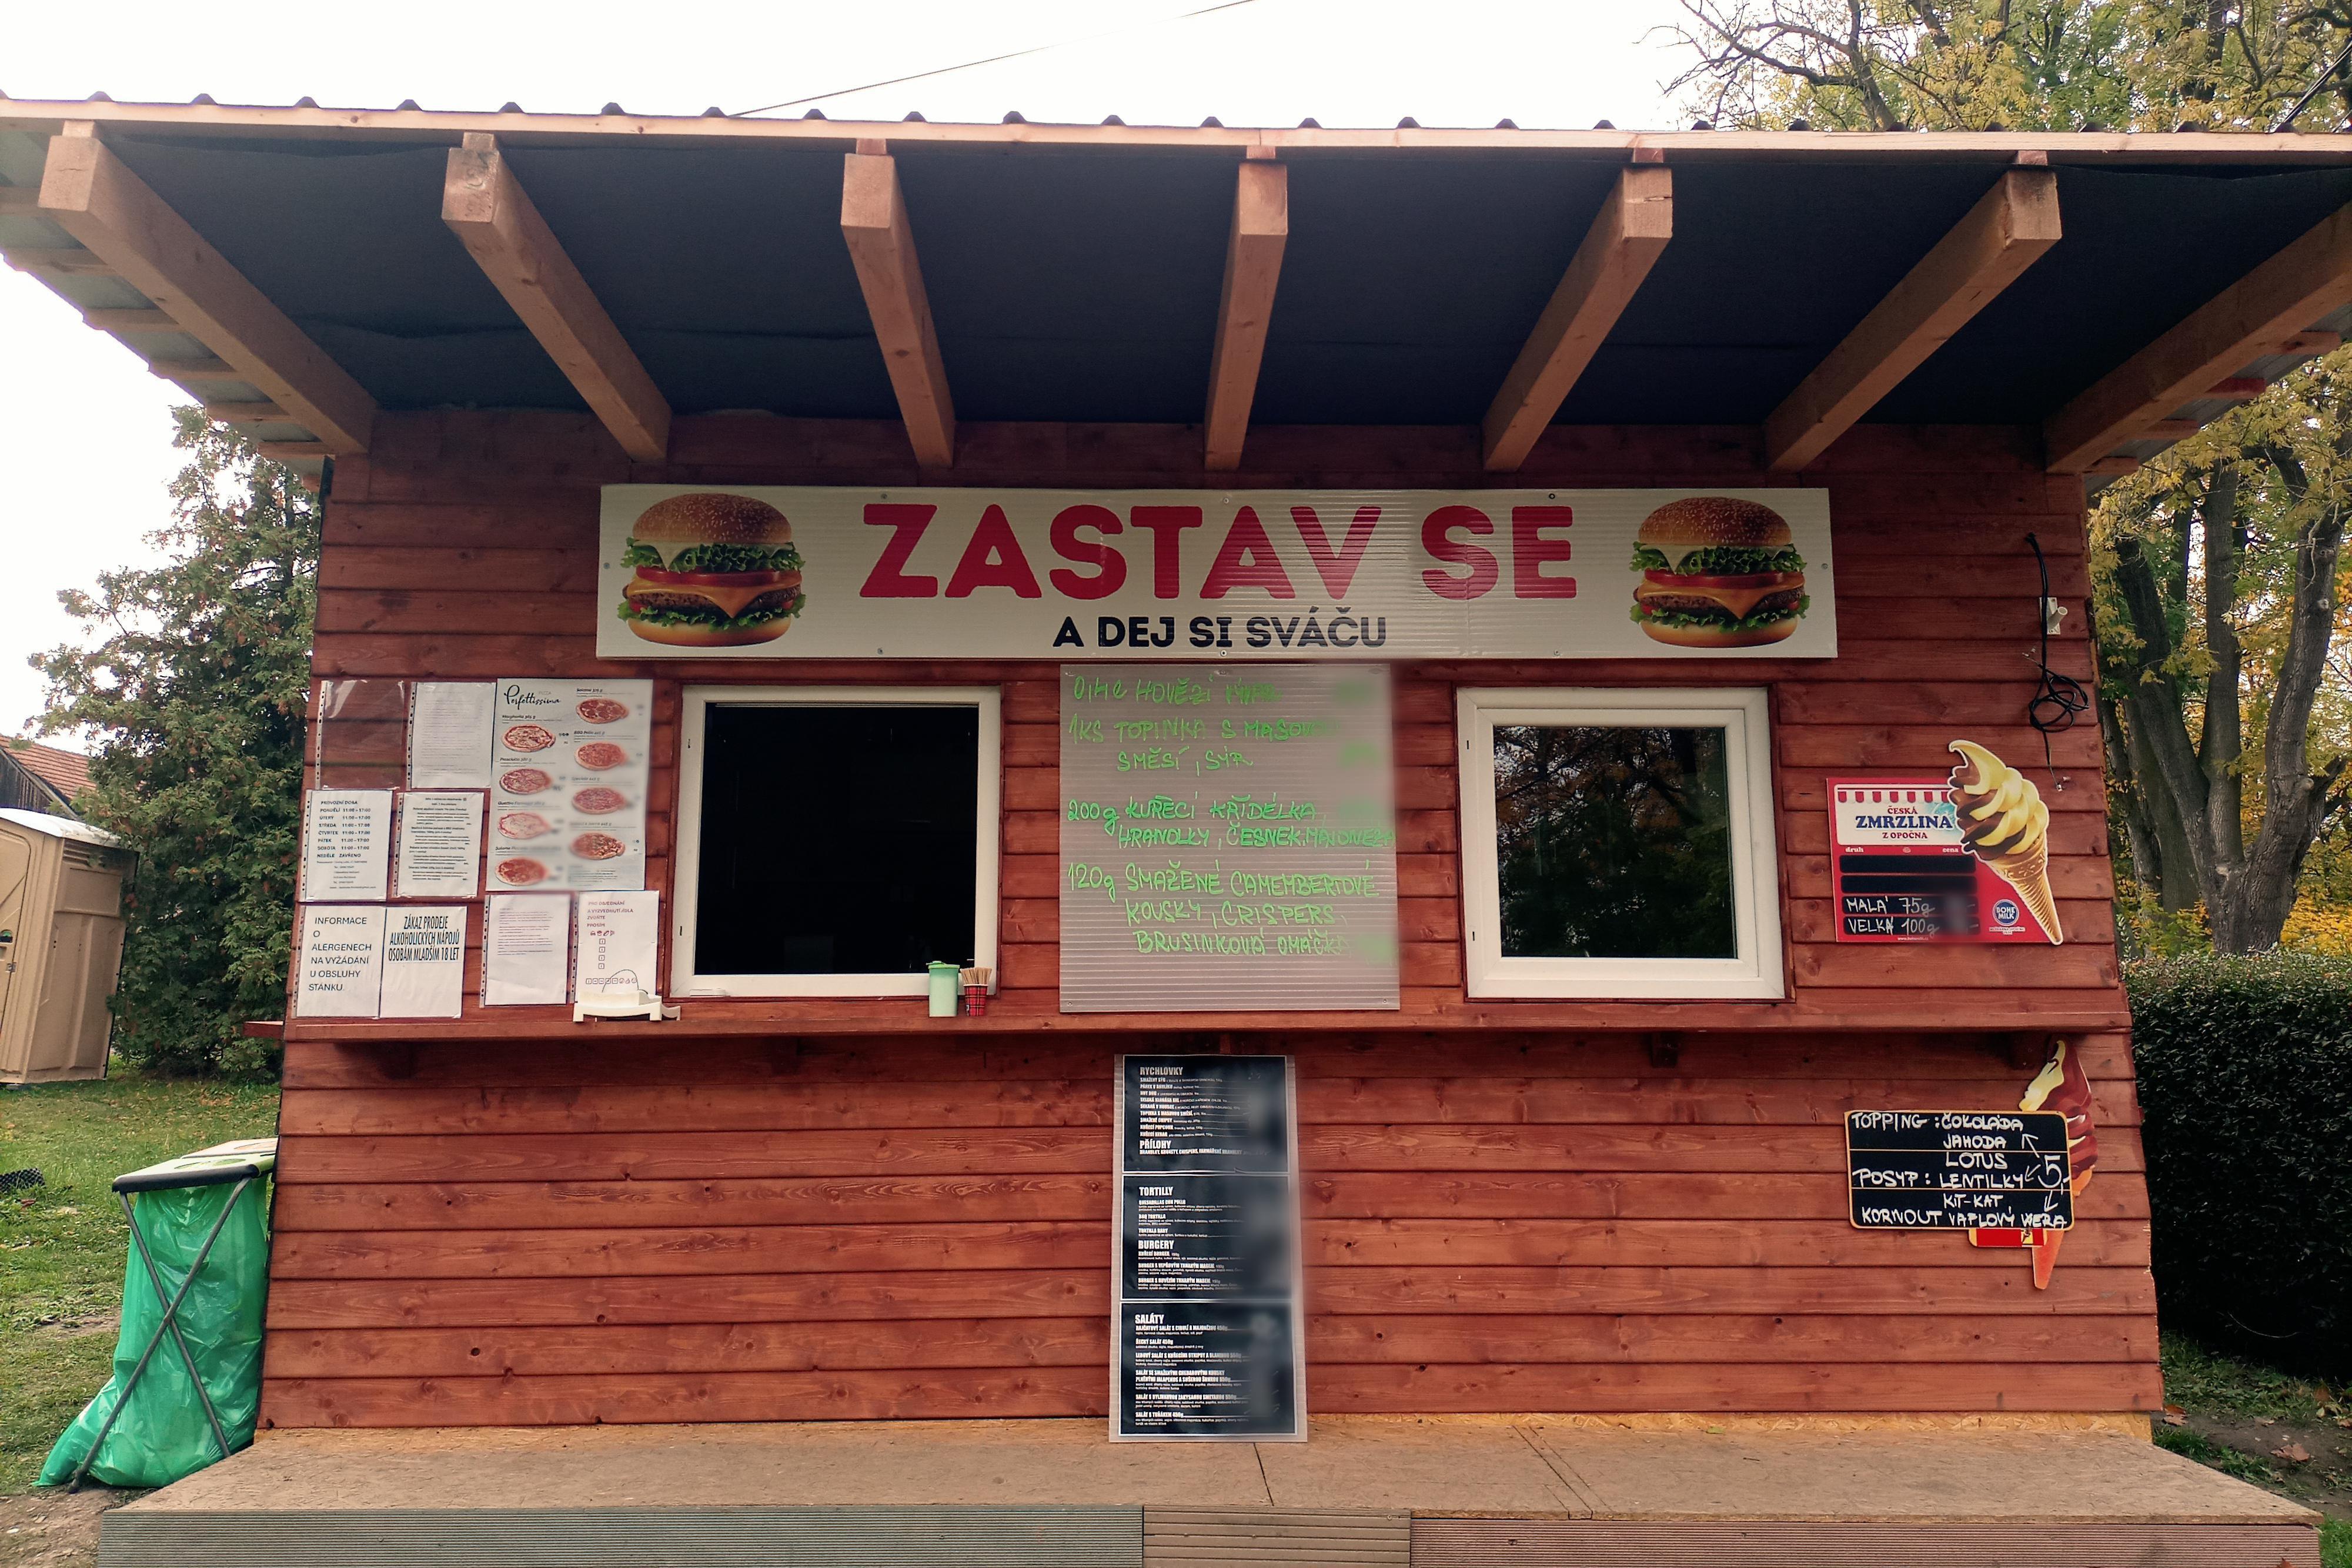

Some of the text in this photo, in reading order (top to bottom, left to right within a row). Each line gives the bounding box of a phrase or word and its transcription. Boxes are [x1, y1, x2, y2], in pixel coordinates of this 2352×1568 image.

[859, 503, 1577, 600] ZASTAV SE
[1053, 606, 1387, 648] A DEJ SI SVÁČU
[1114, 717, 1206, 743] TOPINKA
[1221, 718, 1236, 739] S
[1244, 718, 1340, 742] MASOV
[1206, 745, 1254, 771] SÝR
[1068, 799, 1120, 836] 200g
[1125, 791, 1198, 820] KUŘECÍ
[1887, 805, 1918, 814] ČESKÁ
[1855, 815, 1953, 828] ZMRZLINA
[1890, 830, 1927, 838] OPOČNA
[1068, 858, 1379, 902] 120g SMAŽENÉ CAMEMBERTOVÉ
[1846, 895, 1936, 917] MALÁ 75g
[403, 914, 449, 930] ZÁKAZ PRODEJE
[1847, 916, 1939, 938] VELKÁ 100g
[389, 928, 460, 945] ALKOHOLICKÝCH NÁPOJŮ
[1132, 927, 1265, 956] BRUSINKOVÁ
[325, 955, 369, 964] VYŽÁDÁNÍ
[389, 945, 459, 961] OSOBÁM MLADŠÍM 18 LET
[1140, 1067, 1183, 1075] RYCHLOVKY
[1941, 1112, 2024, 1131] ČOKOLÁDA
[1140, 1139, 1171, 1149] PŘÍLOHY
[1943, 1134, 2007, 1149] JAHODA
[1945, 1152, 2008, 1170] LOTUS
[1939, 1173, 2025, 1189] LENTILKY
[1139, 1186, 1174, 1196] TORTILLY
[1943, 1193, 2003, 1209] KIT-KAT
[1861, 1206, 1942, 1226] KORNOUT
[1138, 1241, 1174, 1249] BURGERY
[1135, 1312, 1164, 1324] SALÁTY
